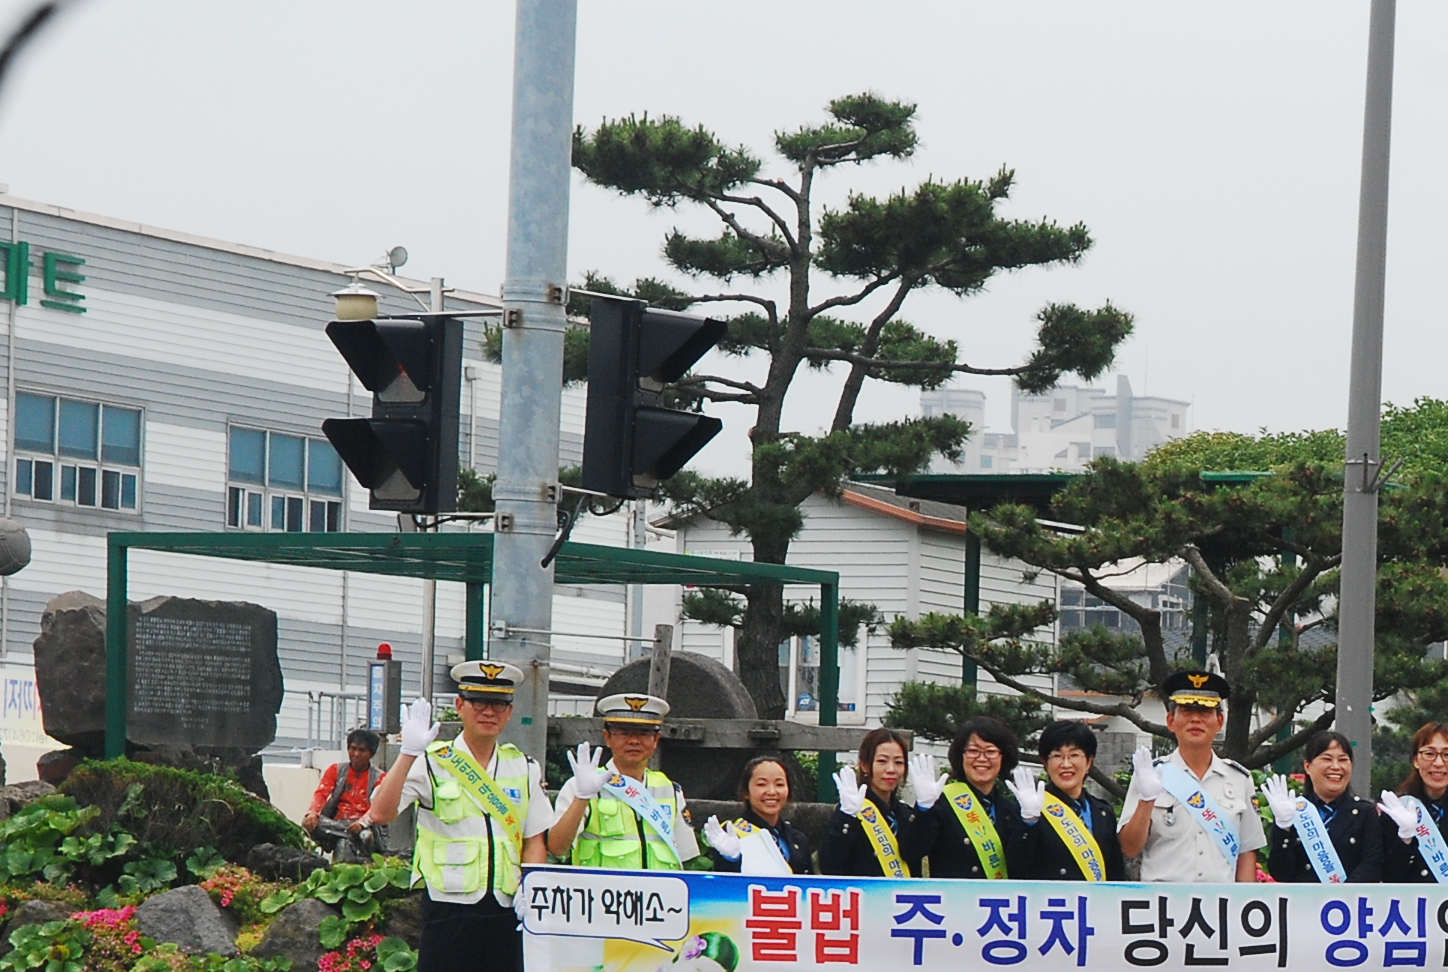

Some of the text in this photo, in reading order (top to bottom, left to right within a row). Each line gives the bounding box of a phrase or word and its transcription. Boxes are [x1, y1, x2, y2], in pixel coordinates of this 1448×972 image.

[450, 754, 482, 785] 도민의
[478, 783, 509, 816] 마음을
[625, 786, 641, 798] 똑
[650, 808, 671, 835] 바른
[1060, 816, 1087, 848] 도민의
[1201, 807, 1238, 857] 똑 바른
[1415, 823, 1430, 838] 똑
[873, 824, 895, 857] 도민의
[966, 810, 981, 824] 똑
[982, 839, 1001, 869] 바른
[1300, 811, 1320, 840] 도민의
[1312, 840, 1335, 873] 마음을
[530, 885, 594, 924] 주차가
[745, 888, 861, 965] 불법
[1120, 896, 1289, 968] 당신의
